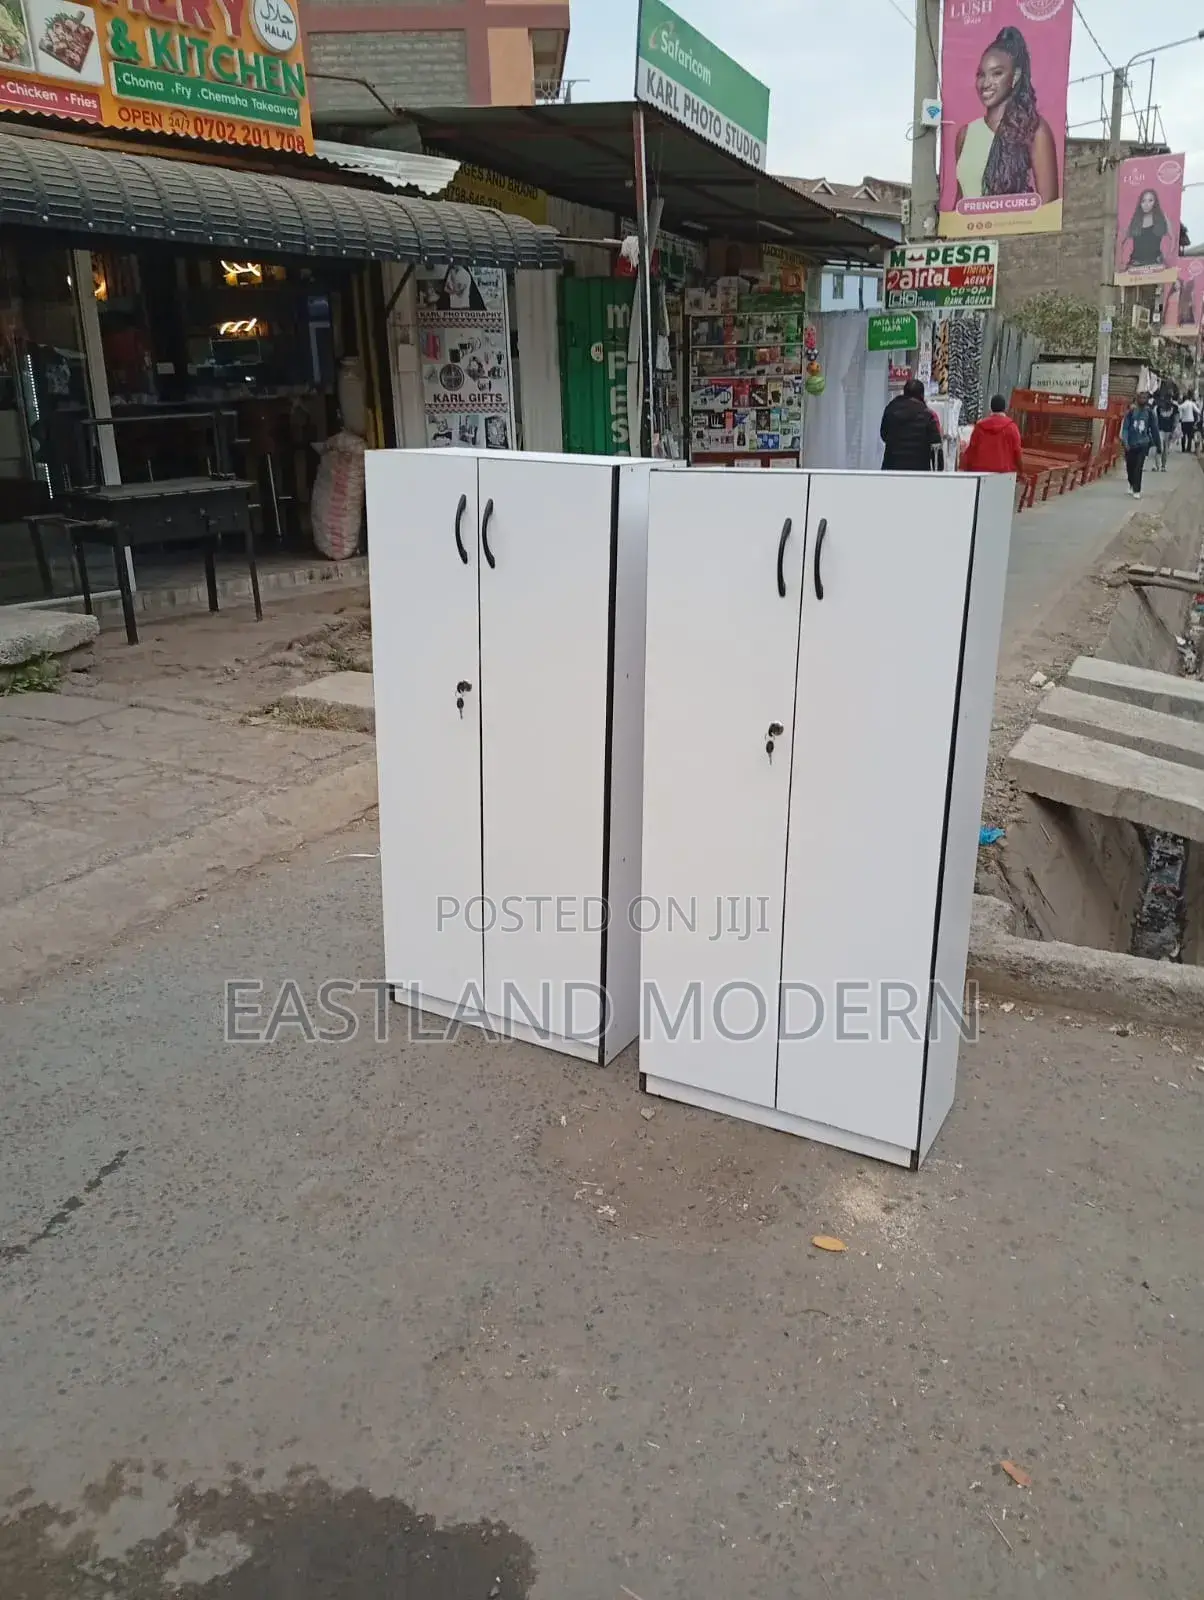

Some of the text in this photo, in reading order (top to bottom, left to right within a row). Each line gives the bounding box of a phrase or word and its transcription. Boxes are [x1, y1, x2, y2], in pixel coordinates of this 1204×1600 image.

[264, 22, 293, 42] HALAL
[106, 17, 307, 97] & KITCHEN
[661, 30, 712, 87] Safaricom
[6, 81, 98, 109] Chicken Fries
[123, 72, 299, 120] Choma Fry Chemsha Takeaway
[118, 106, 190, 131] OPEN 24/7
[646, 67, 761, 165] KARL PHOTO STUDIO
[193, 116, 306, 154] 0702 201 708
[963, 197, 1037, 212] FRENCH CURLS
[899, 267, 951, 290] airtel
[963, 275, 993, 287] AGENT
[964, 295, 992, 306] AGENT
[433, 392, 503, 403] KARL GIFTS
